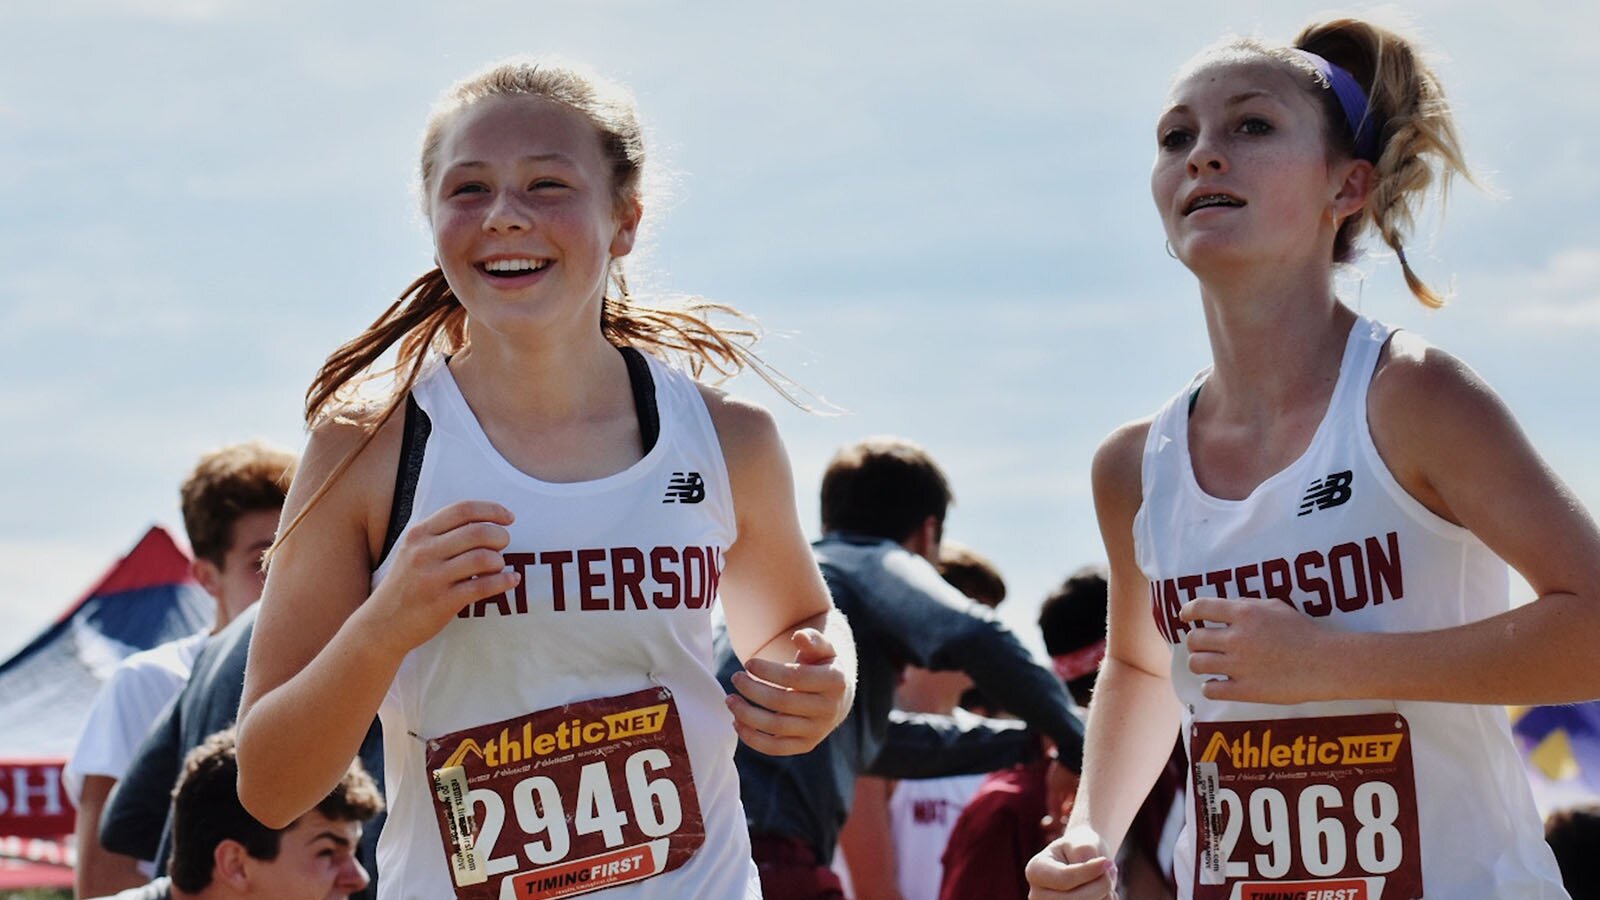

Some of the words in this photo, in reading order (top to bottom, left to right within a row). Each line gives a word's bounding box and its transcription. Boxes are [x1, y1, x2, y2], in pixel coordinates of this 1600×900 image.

[457, 546, 721, 618] ATTERSON
[440, 718, 605, 769] Athletic
[614, 711, 661, 734] NET
[1200, 729, 1341, 769] Athletic
[1348, 742, 1394, 759] NET
[466, 748, 683, 877] 2946
[1217, 780, 1403, 879] 2968
[526, 855, 644, 895] TIMINGFIRST
